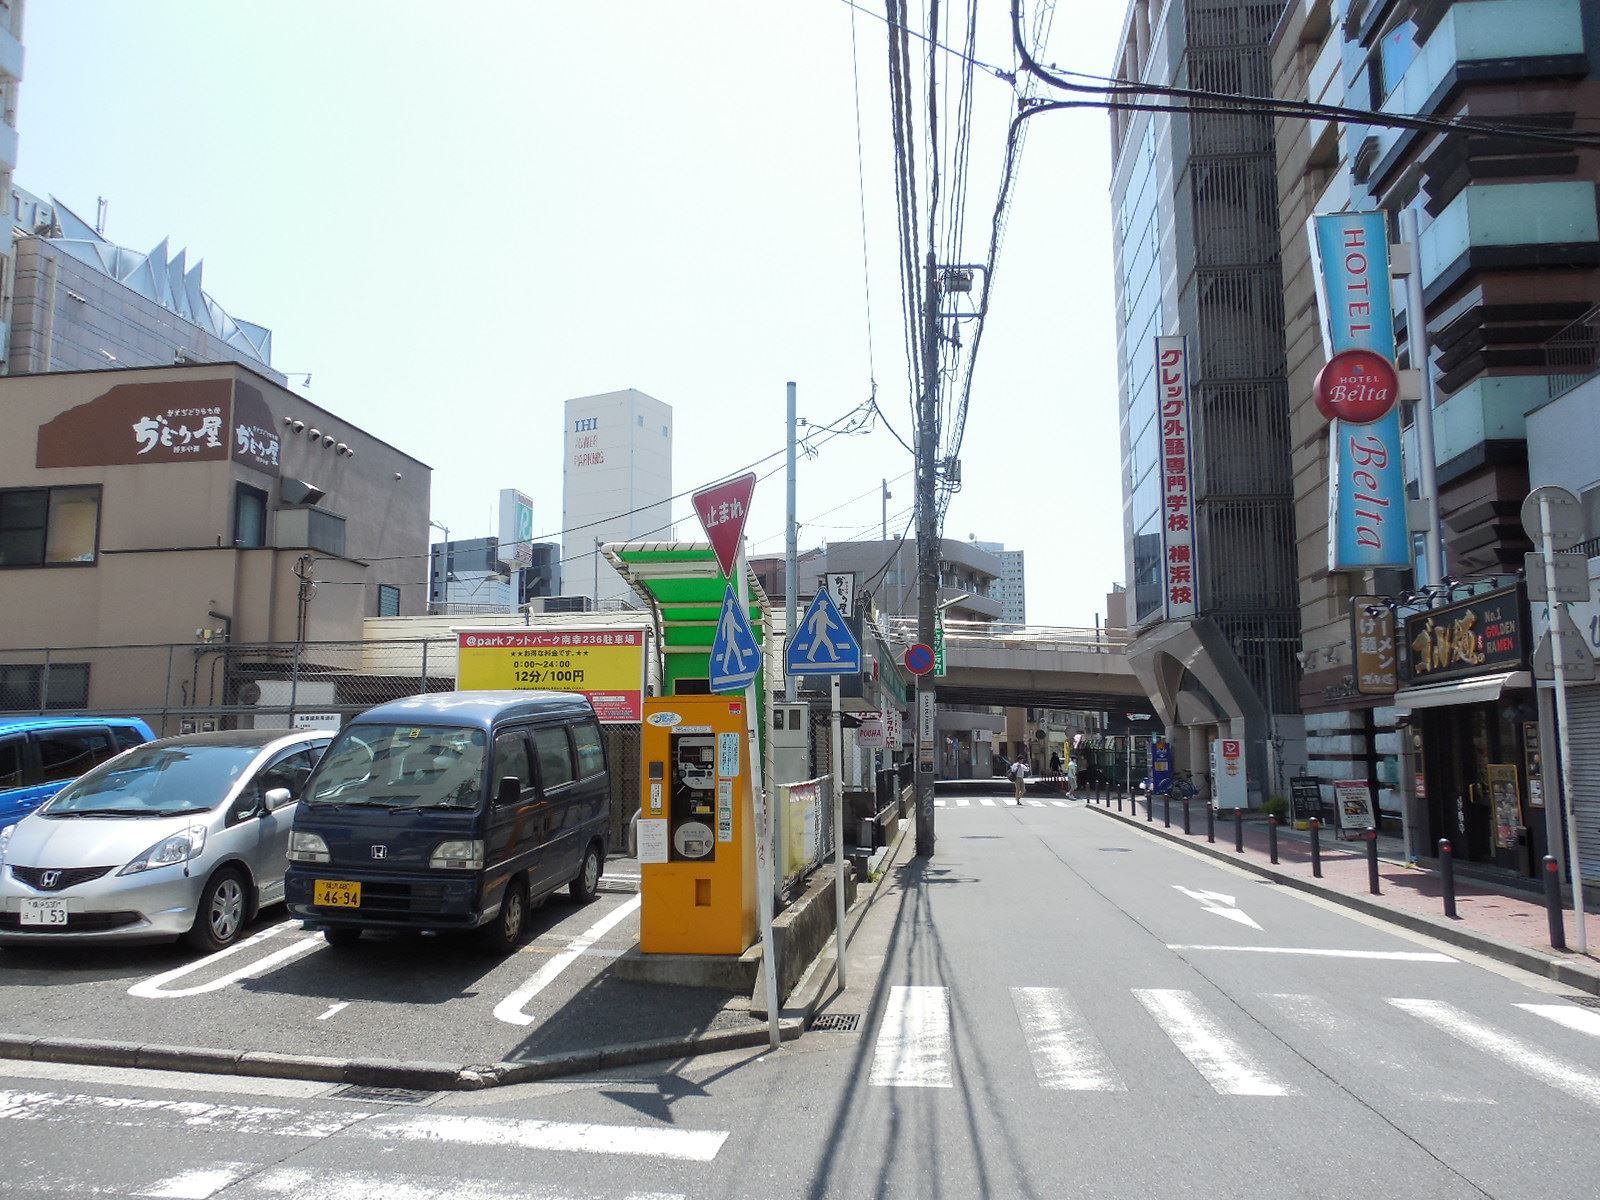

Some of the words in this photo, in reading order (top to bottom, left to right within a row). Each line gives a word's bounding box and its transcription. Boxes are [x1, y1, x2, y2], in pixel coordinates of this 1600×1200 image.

[1343, 228, 1371, 338] HOTEL
[1340, 375, 1380, 384] HOTEL
[1329, 384, 1388, 403] Belta
[574, 417, 599, 433] IHI
[1161, 349, 1190, 532] グレッグ外語専門学校
[1350, 436, 1390, 549] Belta
[706, 498, 744, 528] 止まれ
[1168, 544, 1192, 605] 横浜校
[1484, 608, 1502, 622] No.1
[1486, 621, 1516, 638] GOLDEN
[466, 635, 504, 647] @park
[1486, 637, 1514, 653] RAMEN
[514, 670, 585, 683] 12分/100円
[323, 890, 358, 906] 46-94
